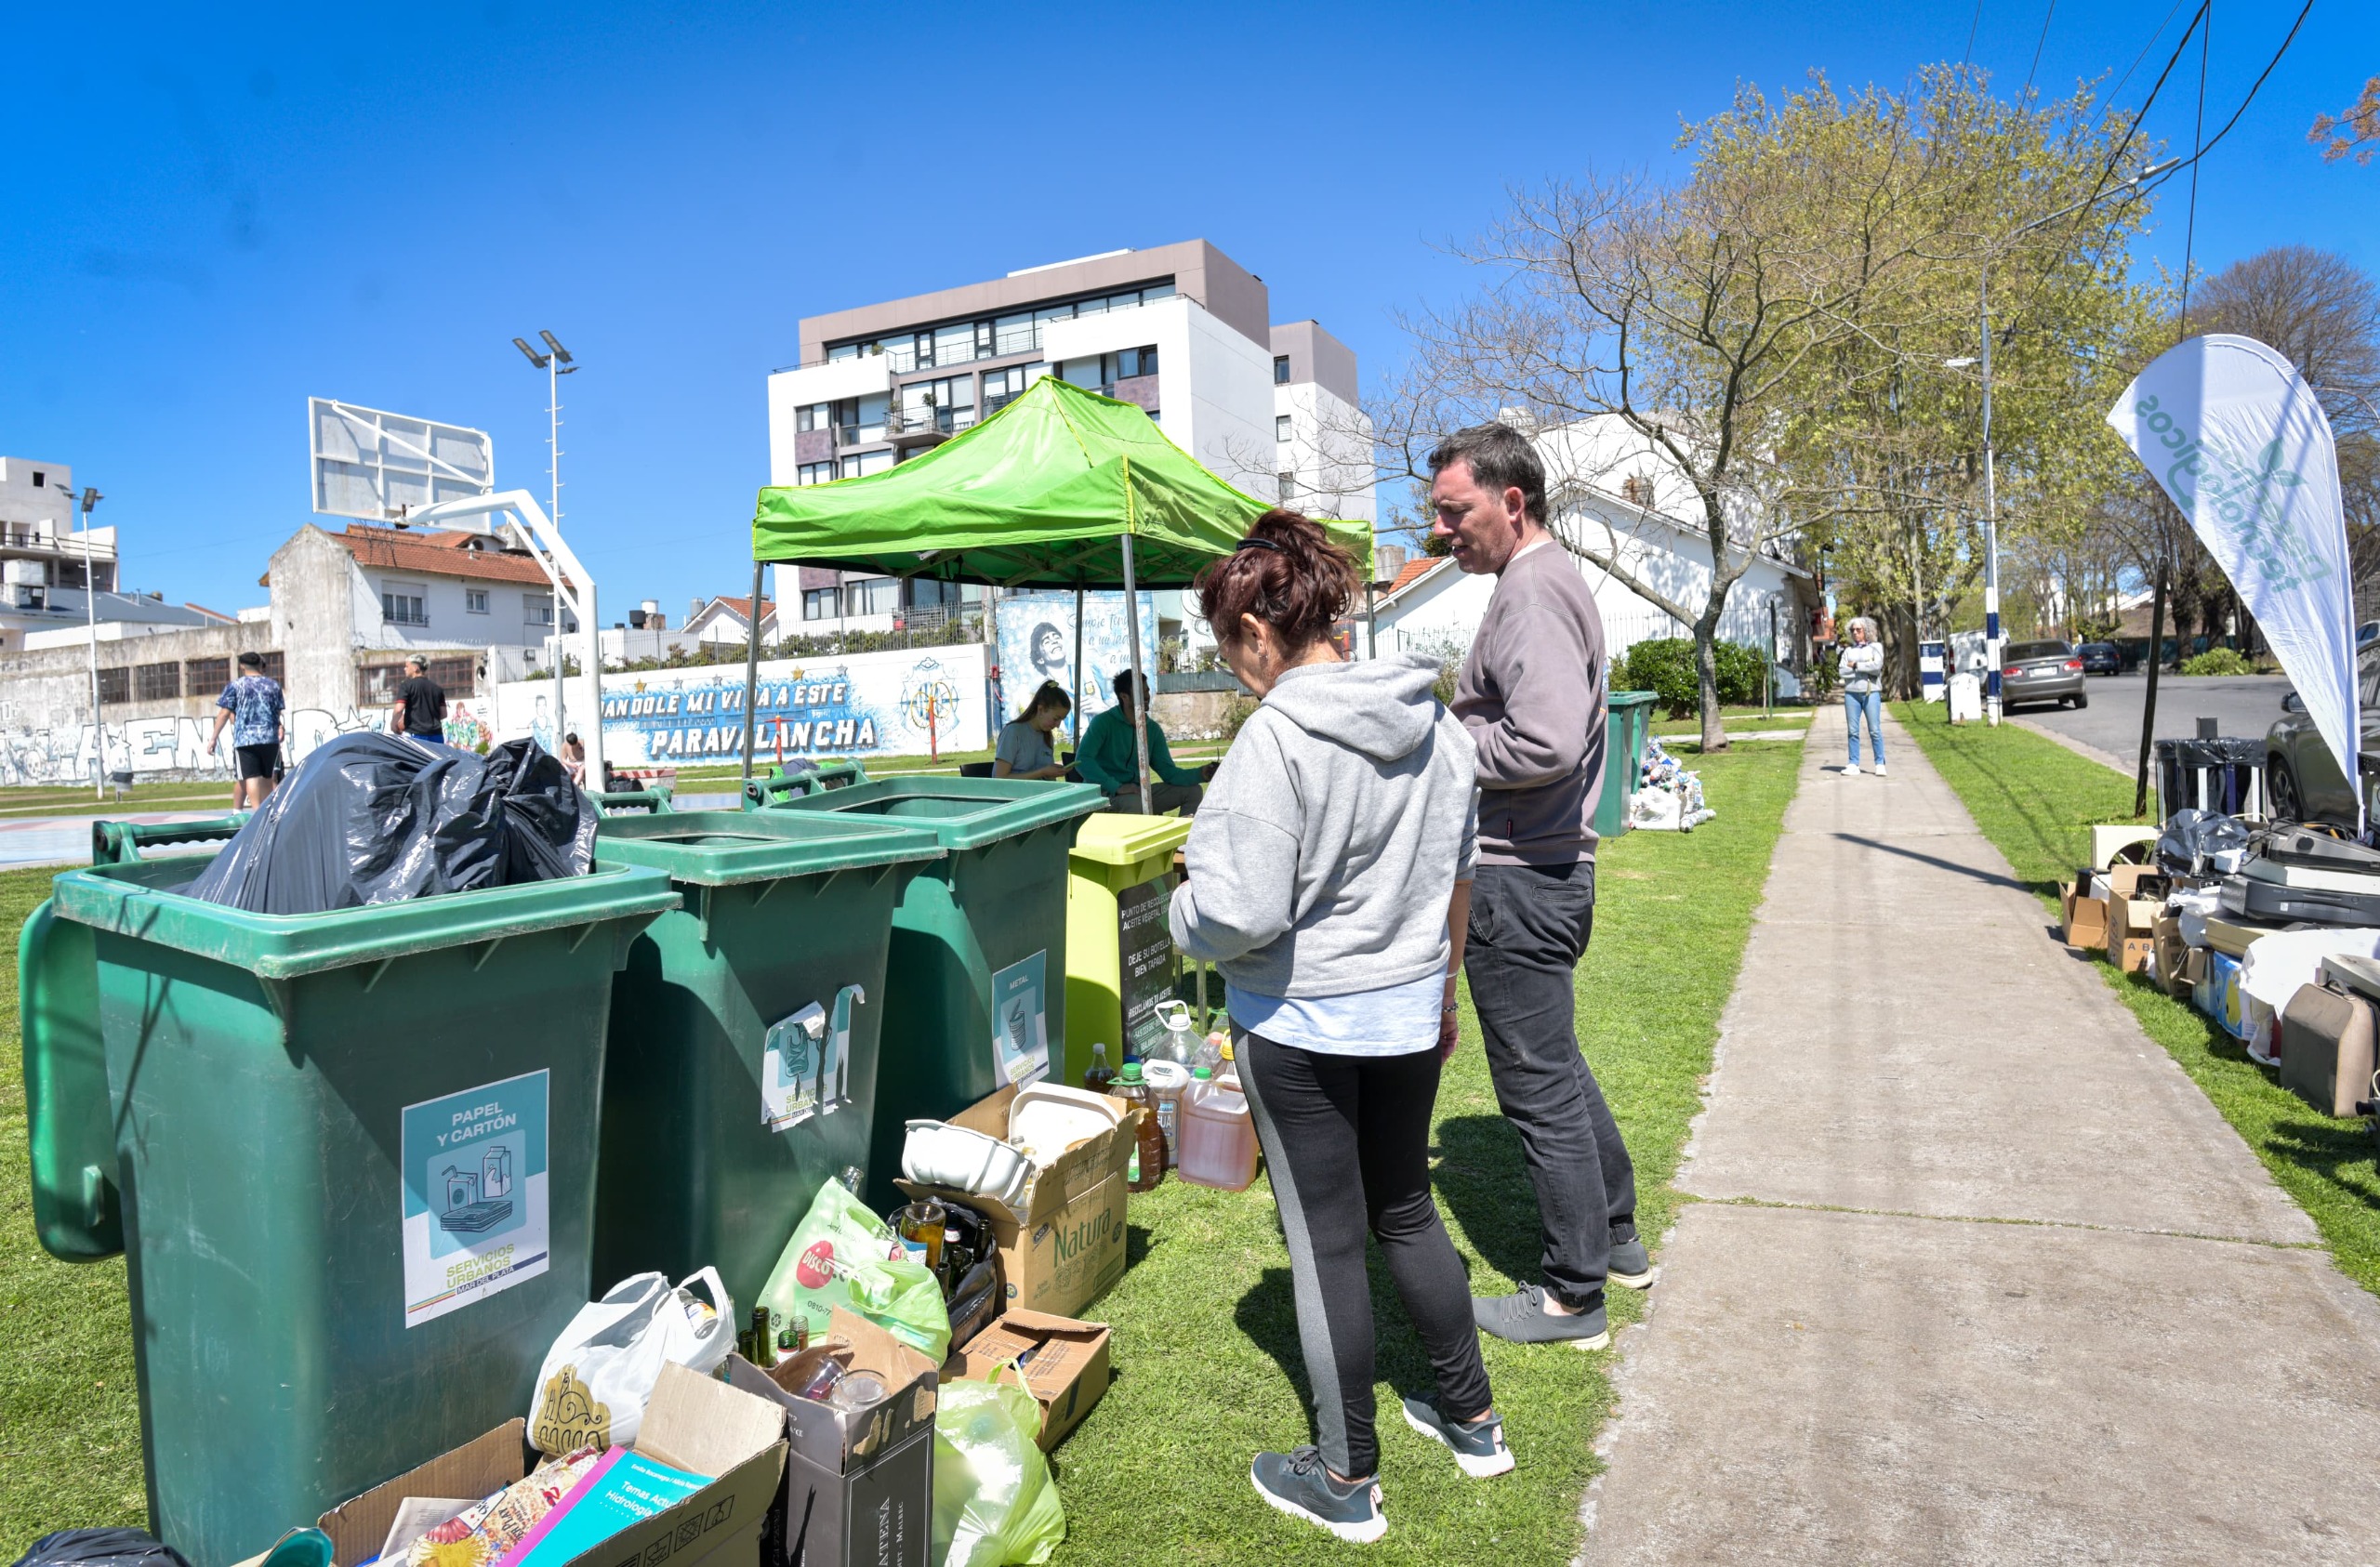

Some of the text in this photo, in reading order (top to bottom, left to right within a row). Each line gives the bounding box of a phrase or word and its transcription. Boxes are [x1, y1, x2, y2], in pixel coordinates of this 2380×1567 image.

[687, 691, 713, 712] MI
[721, 687, 770, 709] VIA
[775, 686, 788, 704] A
[794, 682, 847, 704] ESTE
[1122, 905, 1140, 919] PUNTO
[1141, 902, 1147, 912] DE
[1123, 915, 1142, 930] ACEITE
[1142, 908, 1161, 924] VEGETAL
[1129, 937, 1171, 966] DEJE SU BOTELLA
[1135, 953, 1166, 978] BIEN TAPADA
[1009, 974, 1029, 991] METAL
[452, 1101, 503, 1126] PAPEL
[437, 1113, 517, 1148] Y CARTÓN
[1054, 1207, 1111, 1269] Natura
[446, 1244, 514, 1278] SERVICIOS
[447, 1256, 510, 1289] URBANOS
[802, 1250, 830, 1275] DISCO
[457, 1266, 514, 1294] MAR DEL PLATA
[807, 1300, 831, 1316] 0810-77
[621, 1481, 650, 1500] Temas
[498, 1508, 517, 1532] PLAY
[879, 1495, 890, 1567] ATENA
